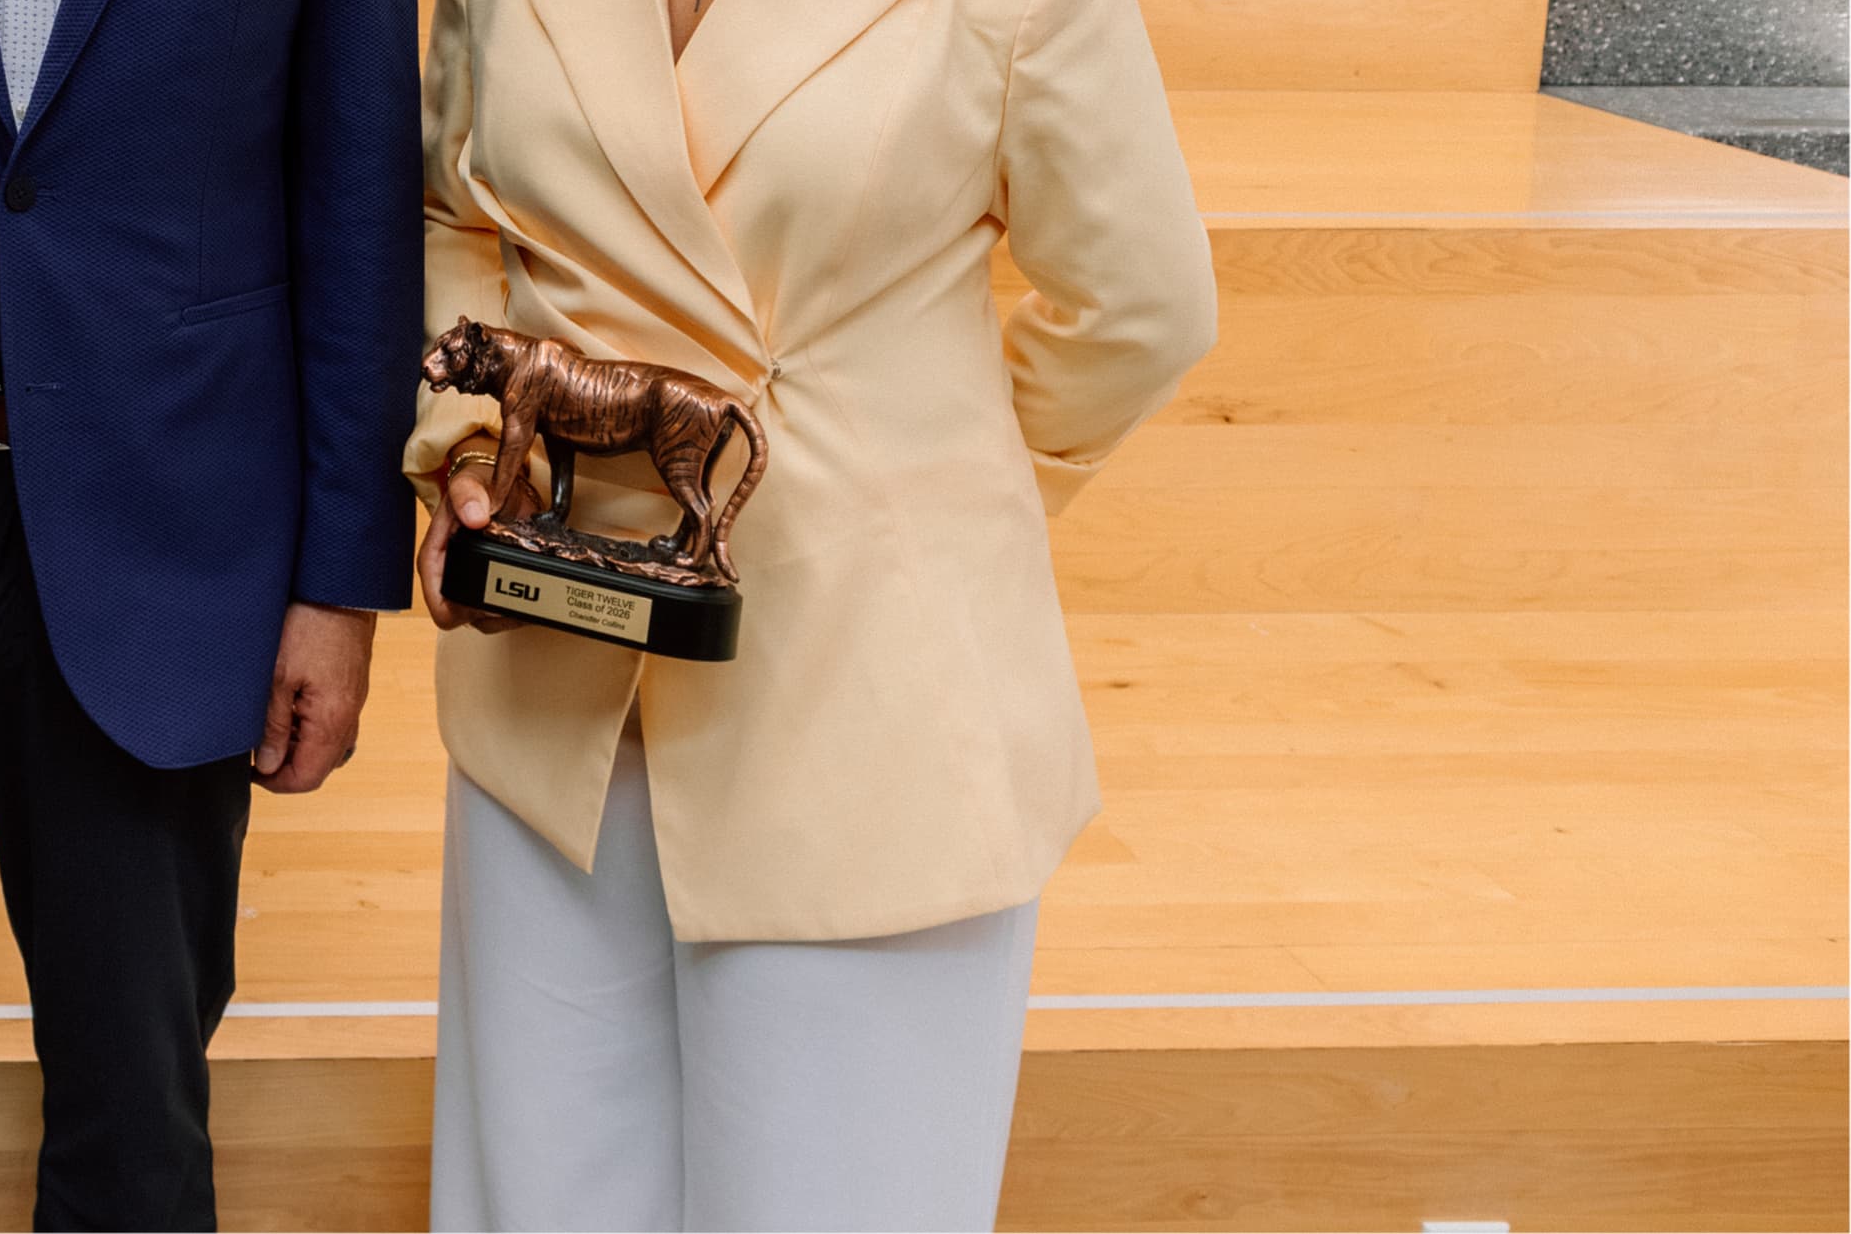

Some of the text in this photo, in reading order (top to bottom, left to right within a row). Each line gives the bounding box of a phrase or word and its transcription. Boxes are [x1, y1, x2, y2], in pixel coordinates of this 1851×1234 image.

[495, 577, 540, 602] LSU
[565, 586, 636, 611] TIGER TWELVE
[567, 596, 631, 620] Class of 2026
